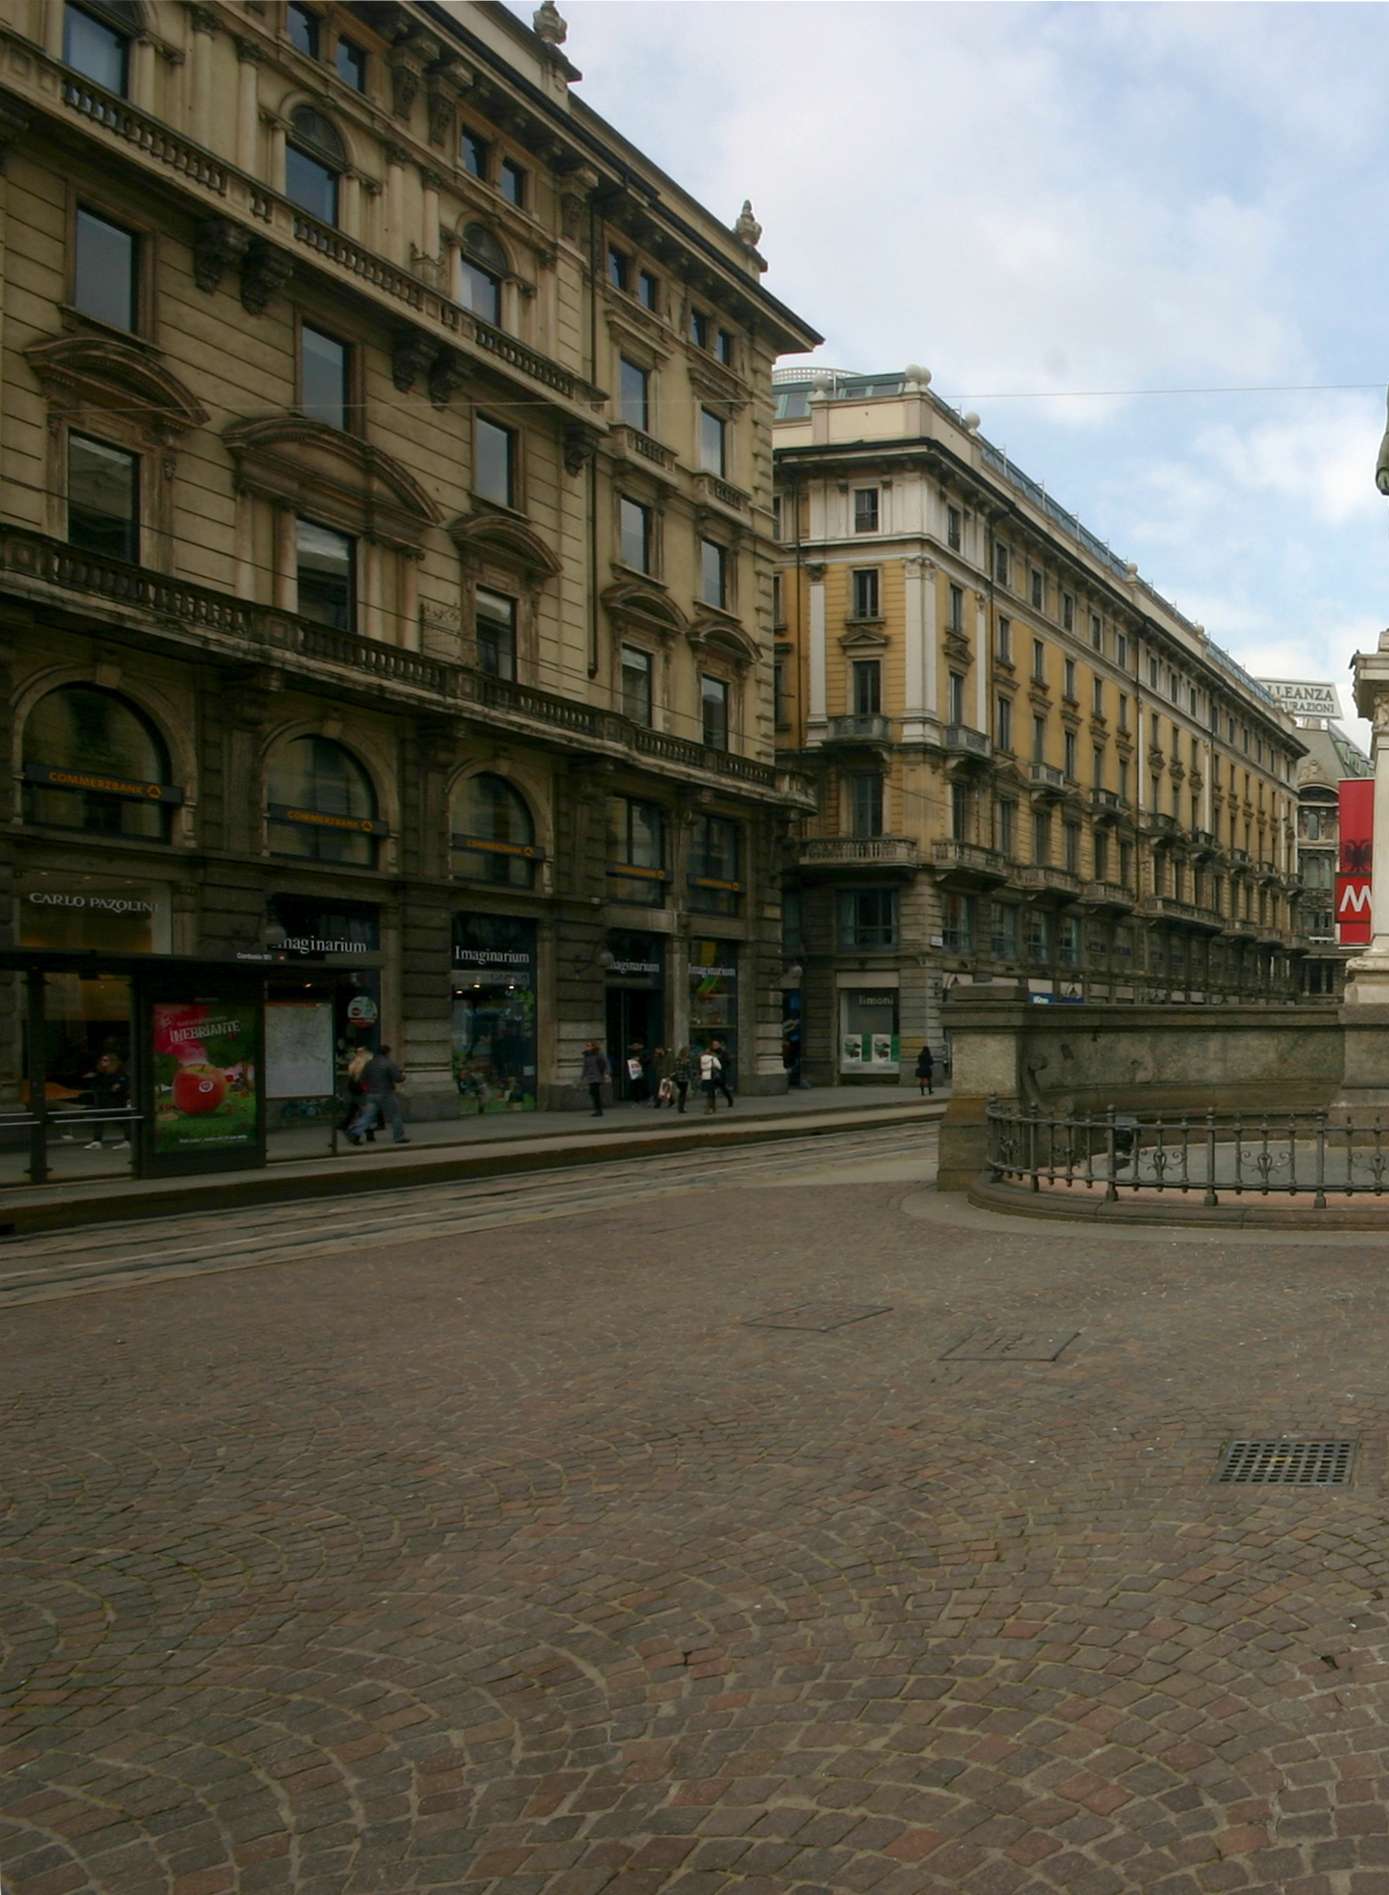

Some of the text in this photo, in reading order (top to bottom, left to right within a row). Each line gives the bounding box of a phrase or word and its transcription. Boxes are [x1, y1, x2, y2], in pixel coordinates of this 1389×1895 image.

[1267, 685, 1334, 702] LEANZA
[1281, 701, 1335, 713] URAZIONI
[48, 771, 145, 795] COMMERZBANK
[28, 892, 159, 914] CARLO PAZOLINI
[1340, 885, 1373, 912] M
[455, 945, 530, 964] Imaginarium
[611, 958, 661, 975] aginarium
[858, 994, 894, 1006] limoni
[169, 1018, 241, 1043] INEBRIANTE
